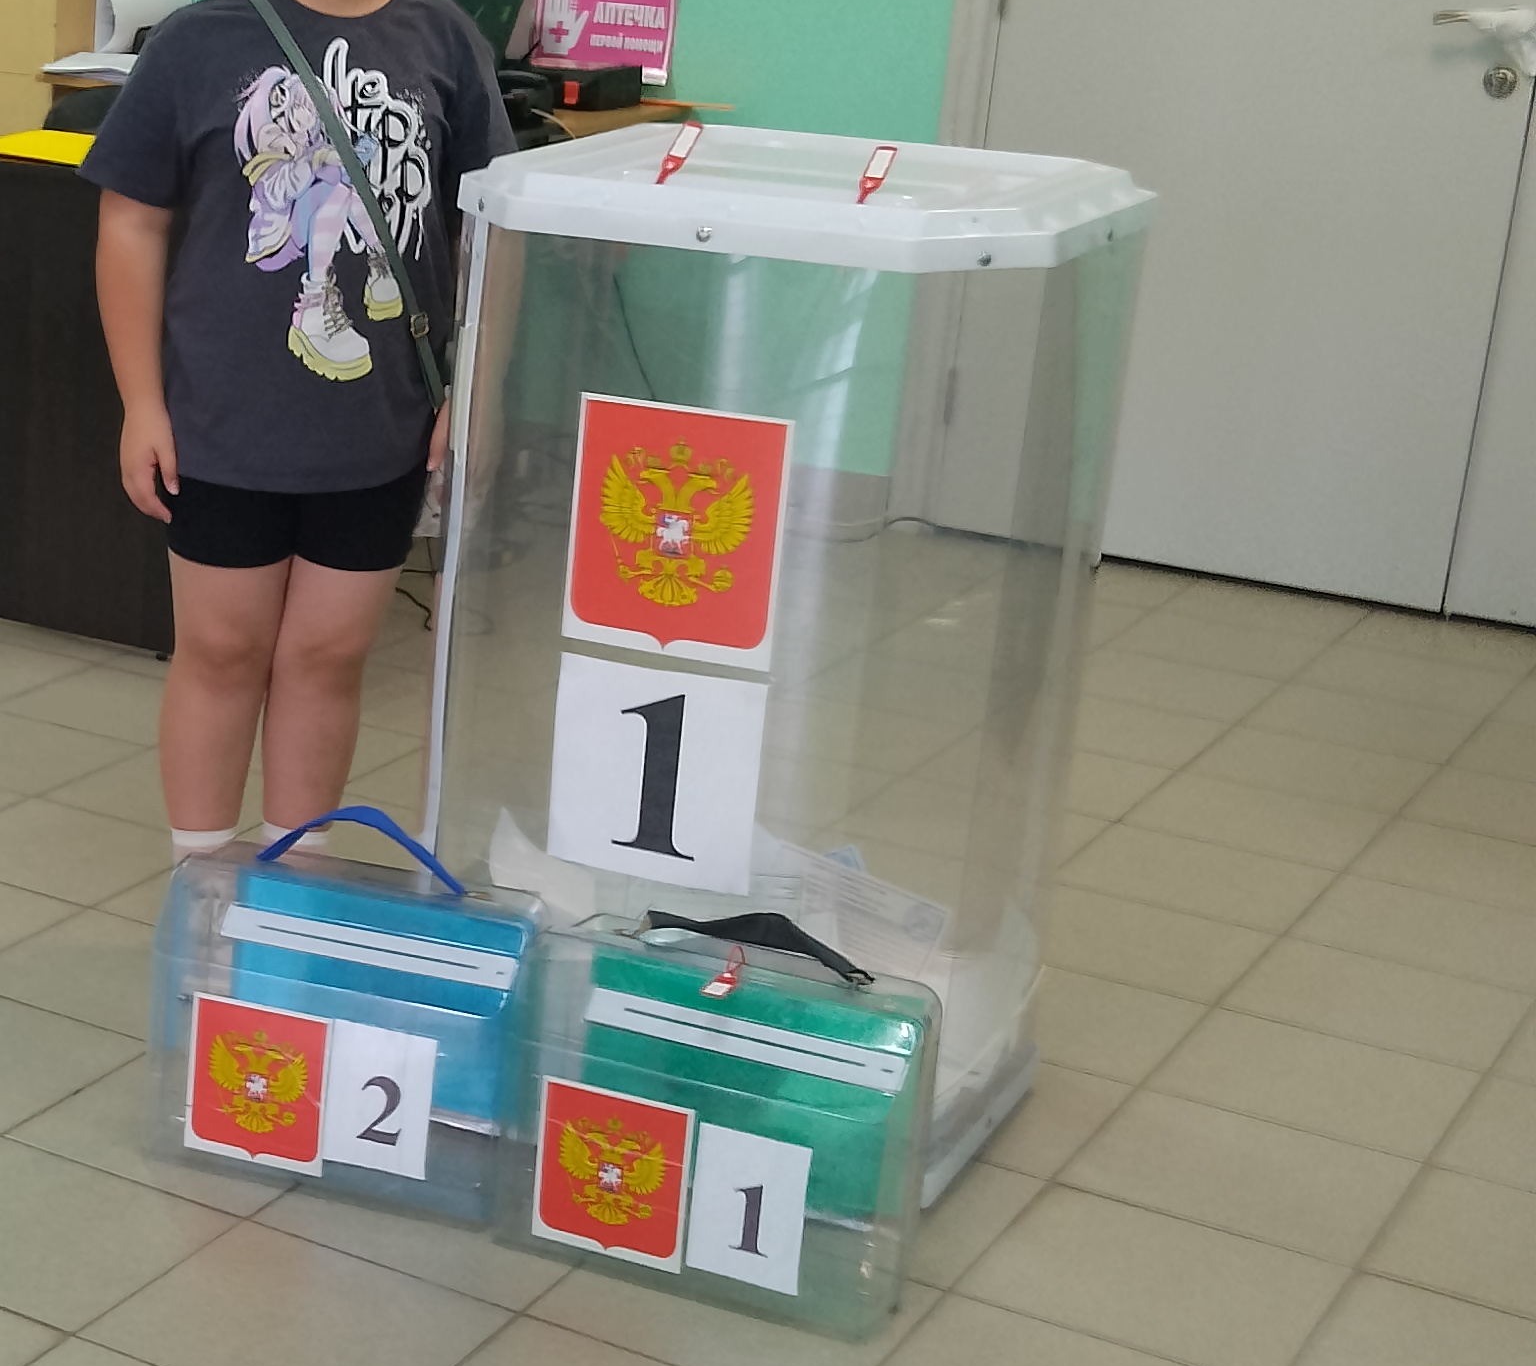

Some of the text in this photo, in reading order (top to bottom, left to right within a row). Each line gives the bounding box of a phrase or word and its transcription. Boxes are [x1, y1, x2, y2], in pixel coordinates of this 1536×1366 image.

[593, 1, 666, 29] АПТЕЧКА
[611, 693, 695, 862] 1
[356, 1075, 402, 1147] 2
[728, 1184, 768, 1259] 1
